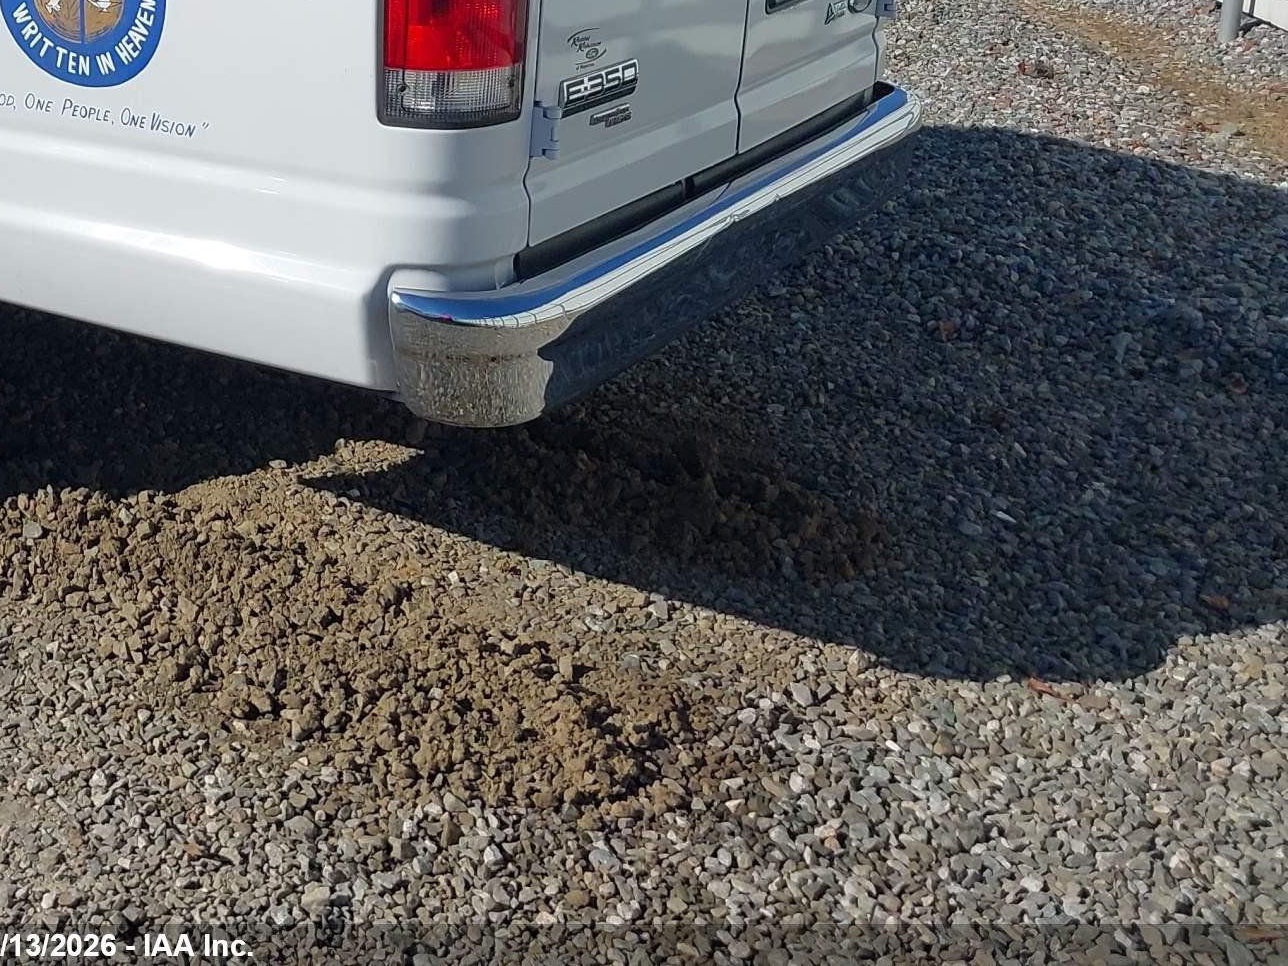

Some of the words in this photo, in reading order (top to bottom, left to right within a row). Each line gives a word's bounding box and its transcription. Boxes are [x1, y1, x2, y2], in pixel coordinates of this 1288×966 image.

[95, 51, 116, 76] IN
[24, 92, 54, 113] ONE
[120, 106, 147, 130] ONE
